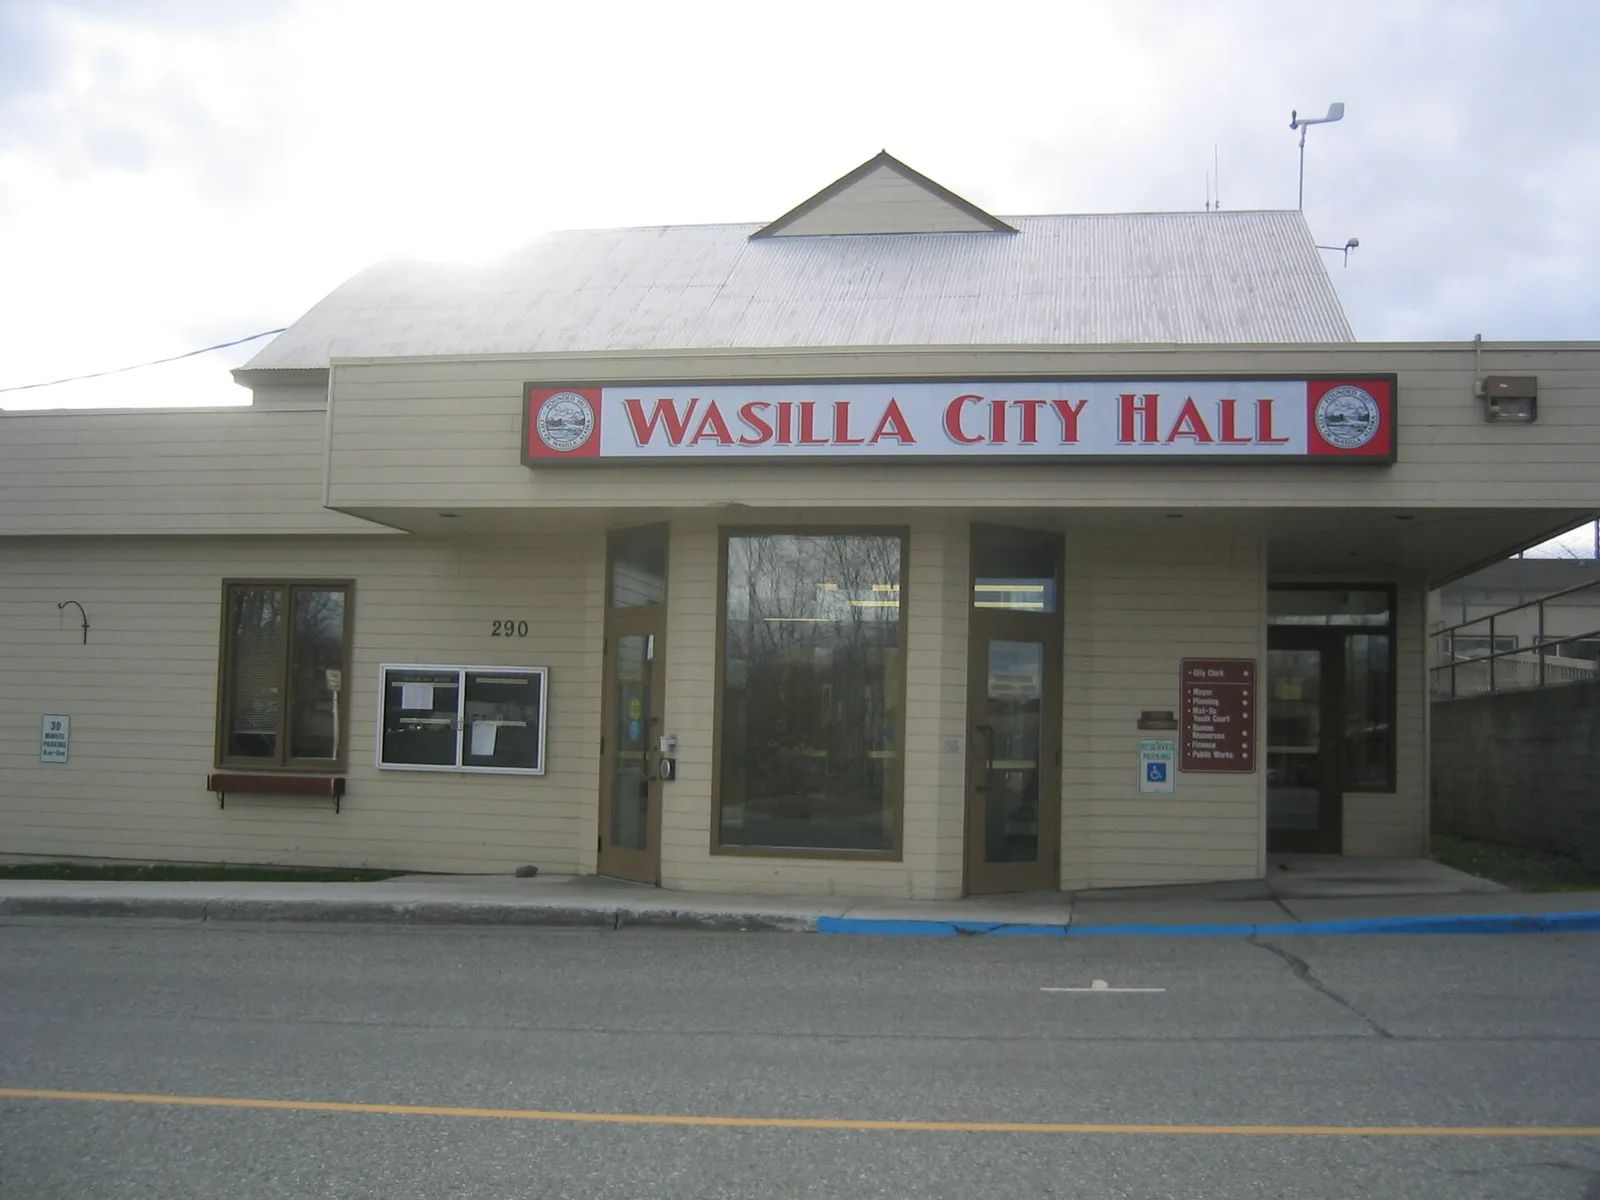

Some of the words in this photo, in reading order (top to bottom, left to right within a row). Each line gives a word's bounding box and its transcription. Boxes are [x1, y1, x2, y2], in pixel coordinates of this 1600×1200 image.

[622, 398, 917, 447] WASILLA
[942, 394, 1088, 445] CITY
[1115, 393, 1290, 445] HALL
[491, 620, 528, 637] 290
[1192, 668, 1207, 677] City
[1207, 669, 1224, 677] Clerk
[1192, 688, 1213, 696] Mayor
[1192, 698, 1219, 707] Planning
[1193, 715, 1211, 723] Youth
[1212, 715, 1230, 723] Court
[50, 721, 62, 731] 30
[1140, 743, 1175, 751] RESERVED
[1142, 752, 1172, 760] PARKING
[1192, 751, 1212, 759] Public
